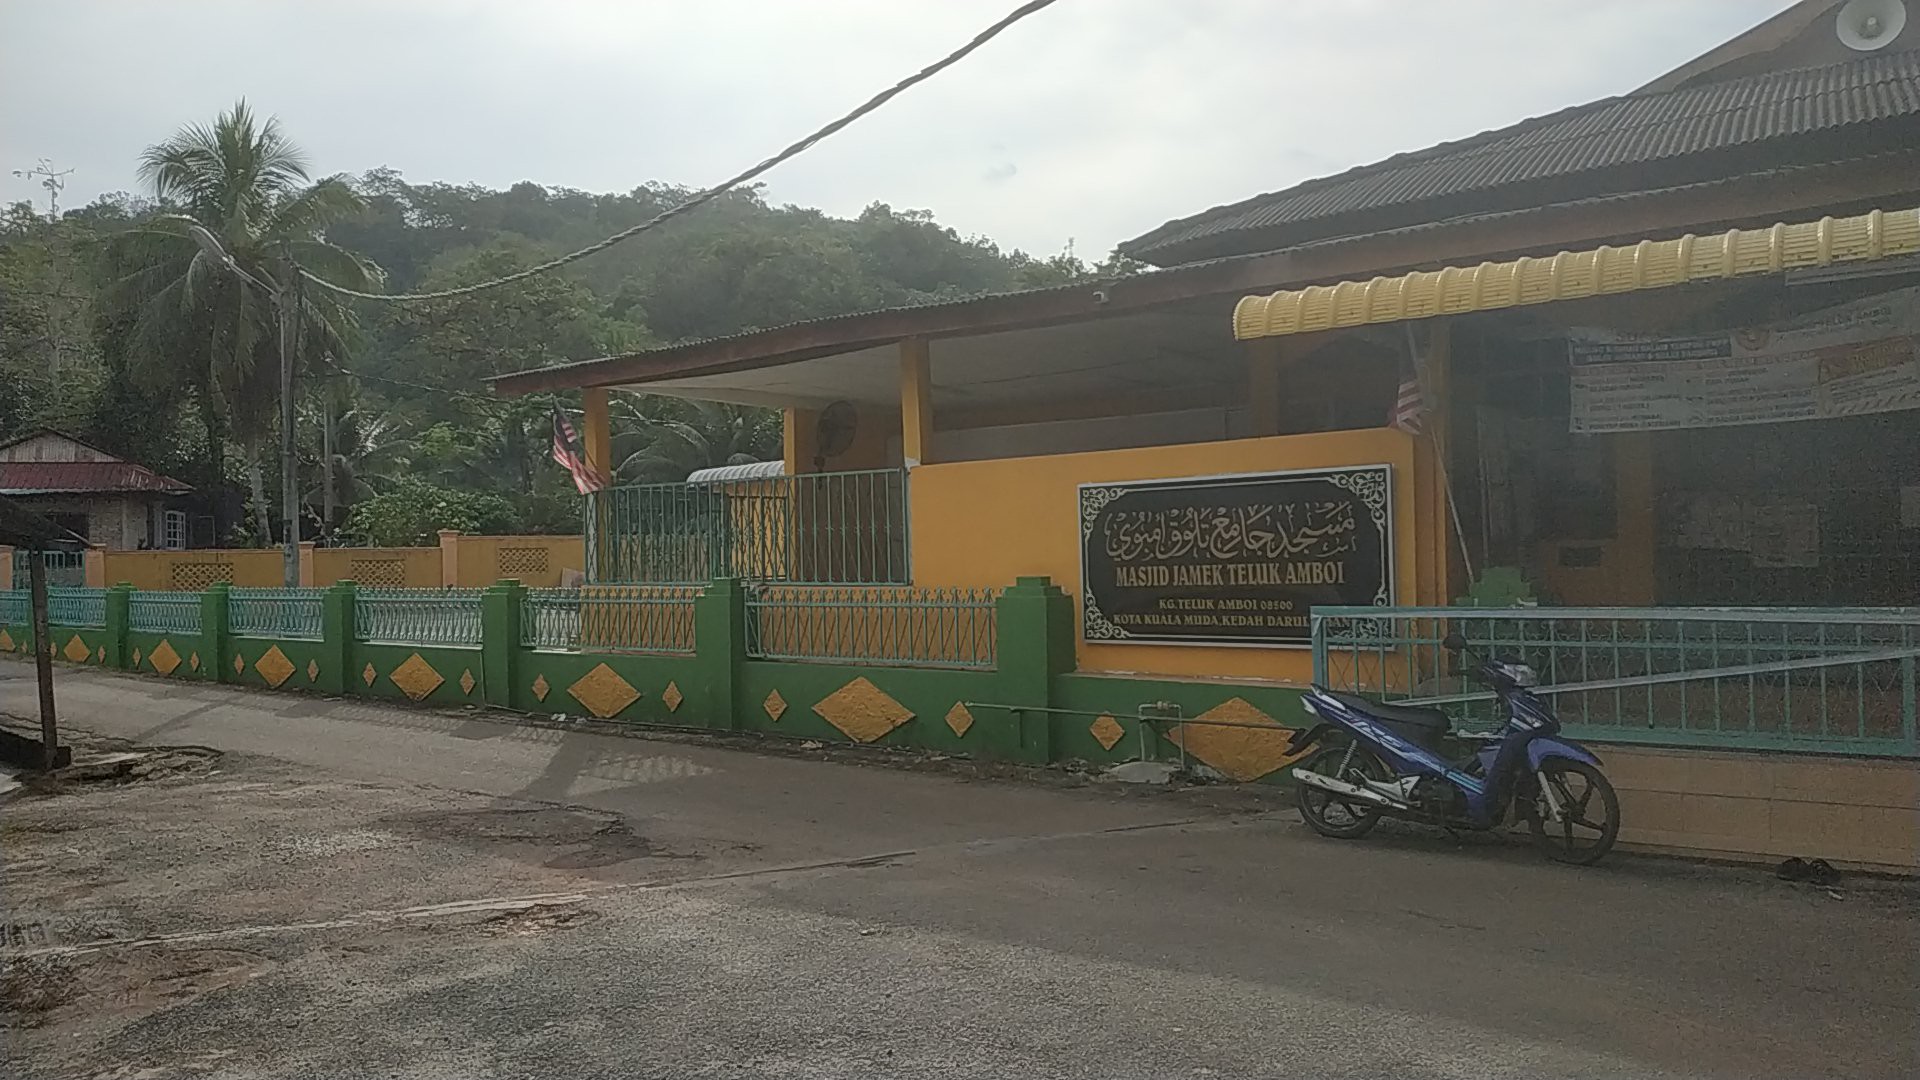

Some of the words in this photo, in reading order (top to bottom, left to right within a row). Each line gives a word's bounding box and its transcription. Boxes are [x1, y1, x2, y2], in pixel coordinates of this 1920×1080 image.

[1116, 565, 1169, 587] MASJID
[1172, 565, 1224, 586] JAMEK
[1227, 564, 1279, 585] TELUK
[1285, 562, 1345, 585] AMBOI
[1217, 599, 1257, 610] AMBOI
[1260, 600, 1293, 610] 08500
[1113, 614, 1142, 625] KOTA
[1144, 614, 1181, 625] KUALA
[1267, 615, 1310, 628] DARUL
